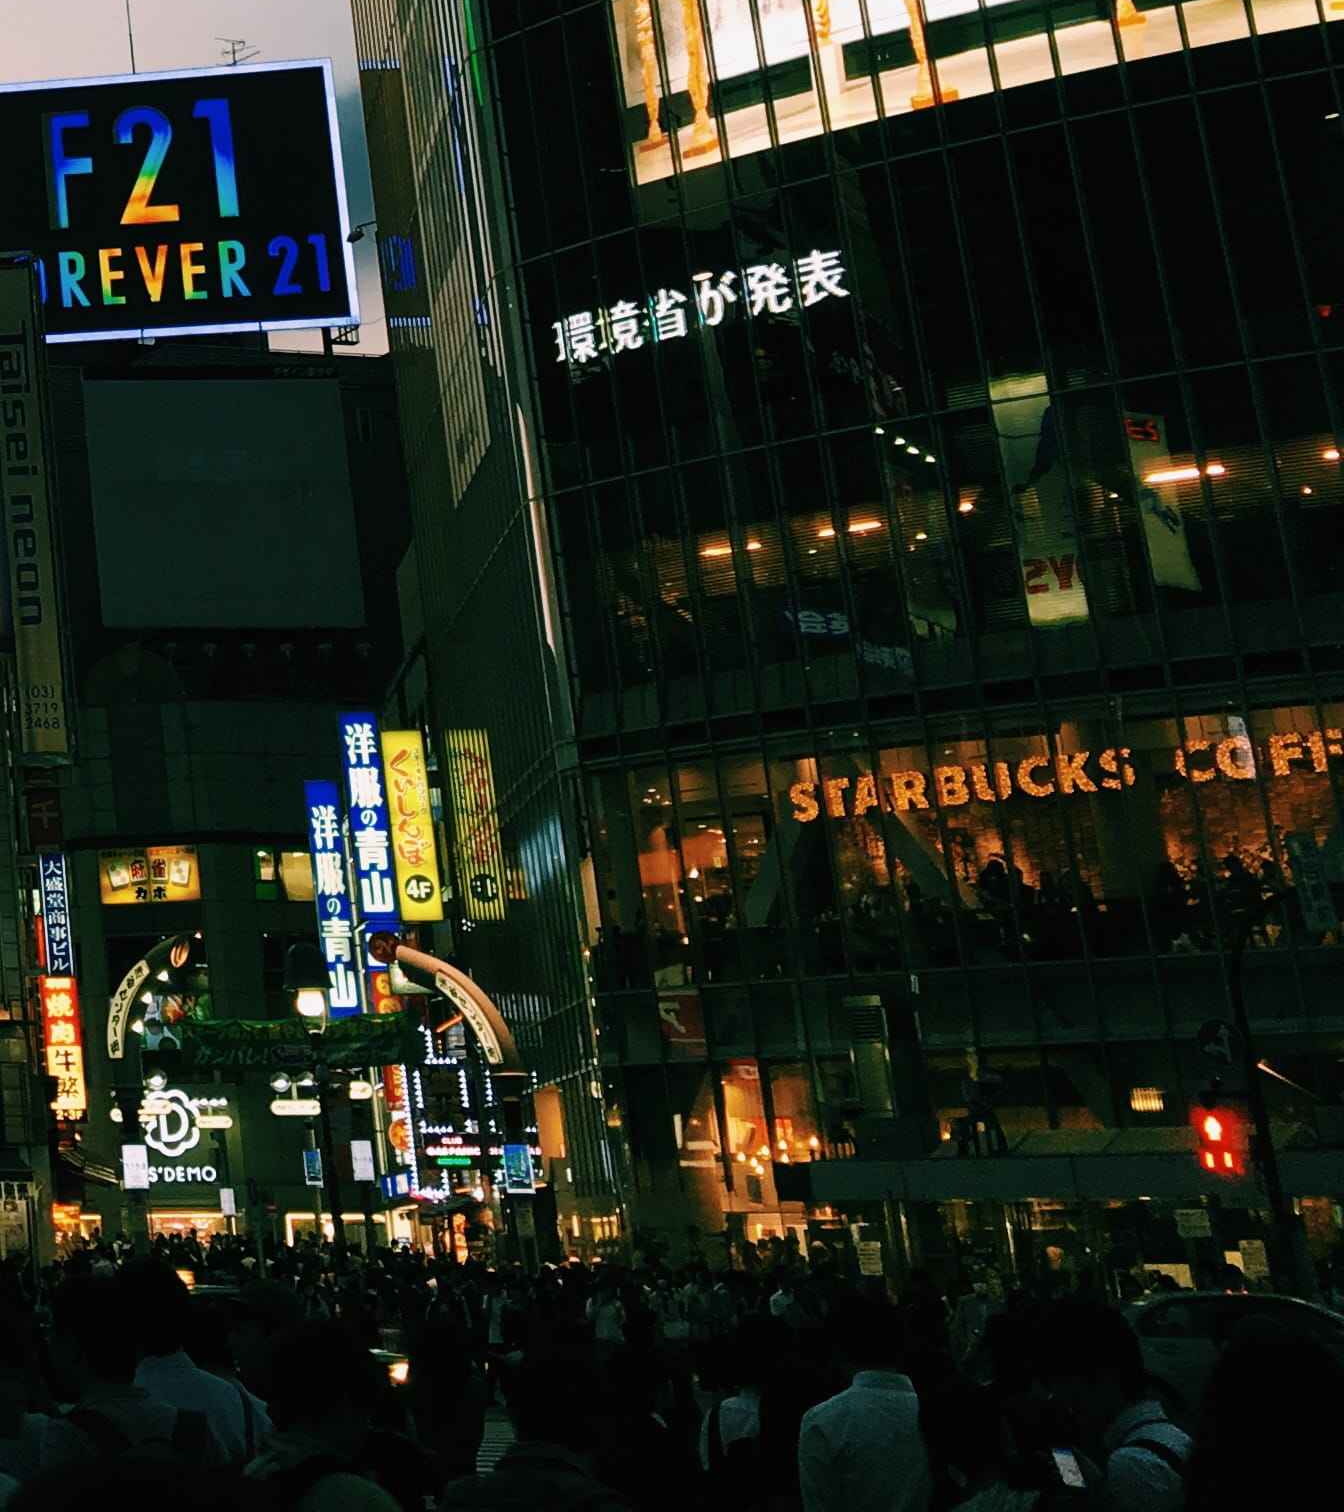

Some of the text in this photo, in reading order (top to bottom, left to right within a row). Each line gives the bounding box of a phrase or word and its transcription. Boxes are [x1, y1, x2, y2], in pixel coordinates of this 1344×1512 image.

[42, 97, 241, 231] F21
[268, 233, 331, 298] 21
[550, 248, 852, 364] 環境省が発表
[10, 493, 42, 627] neon
[24, 701, 59, 717] 3719
[25, 715, 60, 731] 2468
[344, 722, 395, 914] 洋服の青山
[789, 746, 1136, 824] STARBUCKS
[43, 859, 71, 974] 大盛堂商事ビル
[311, 804, 359, 1012] 洋服の青山
[406, 878, 432, 899] 4F
[46, 999, 75, 1045] 焼肉
